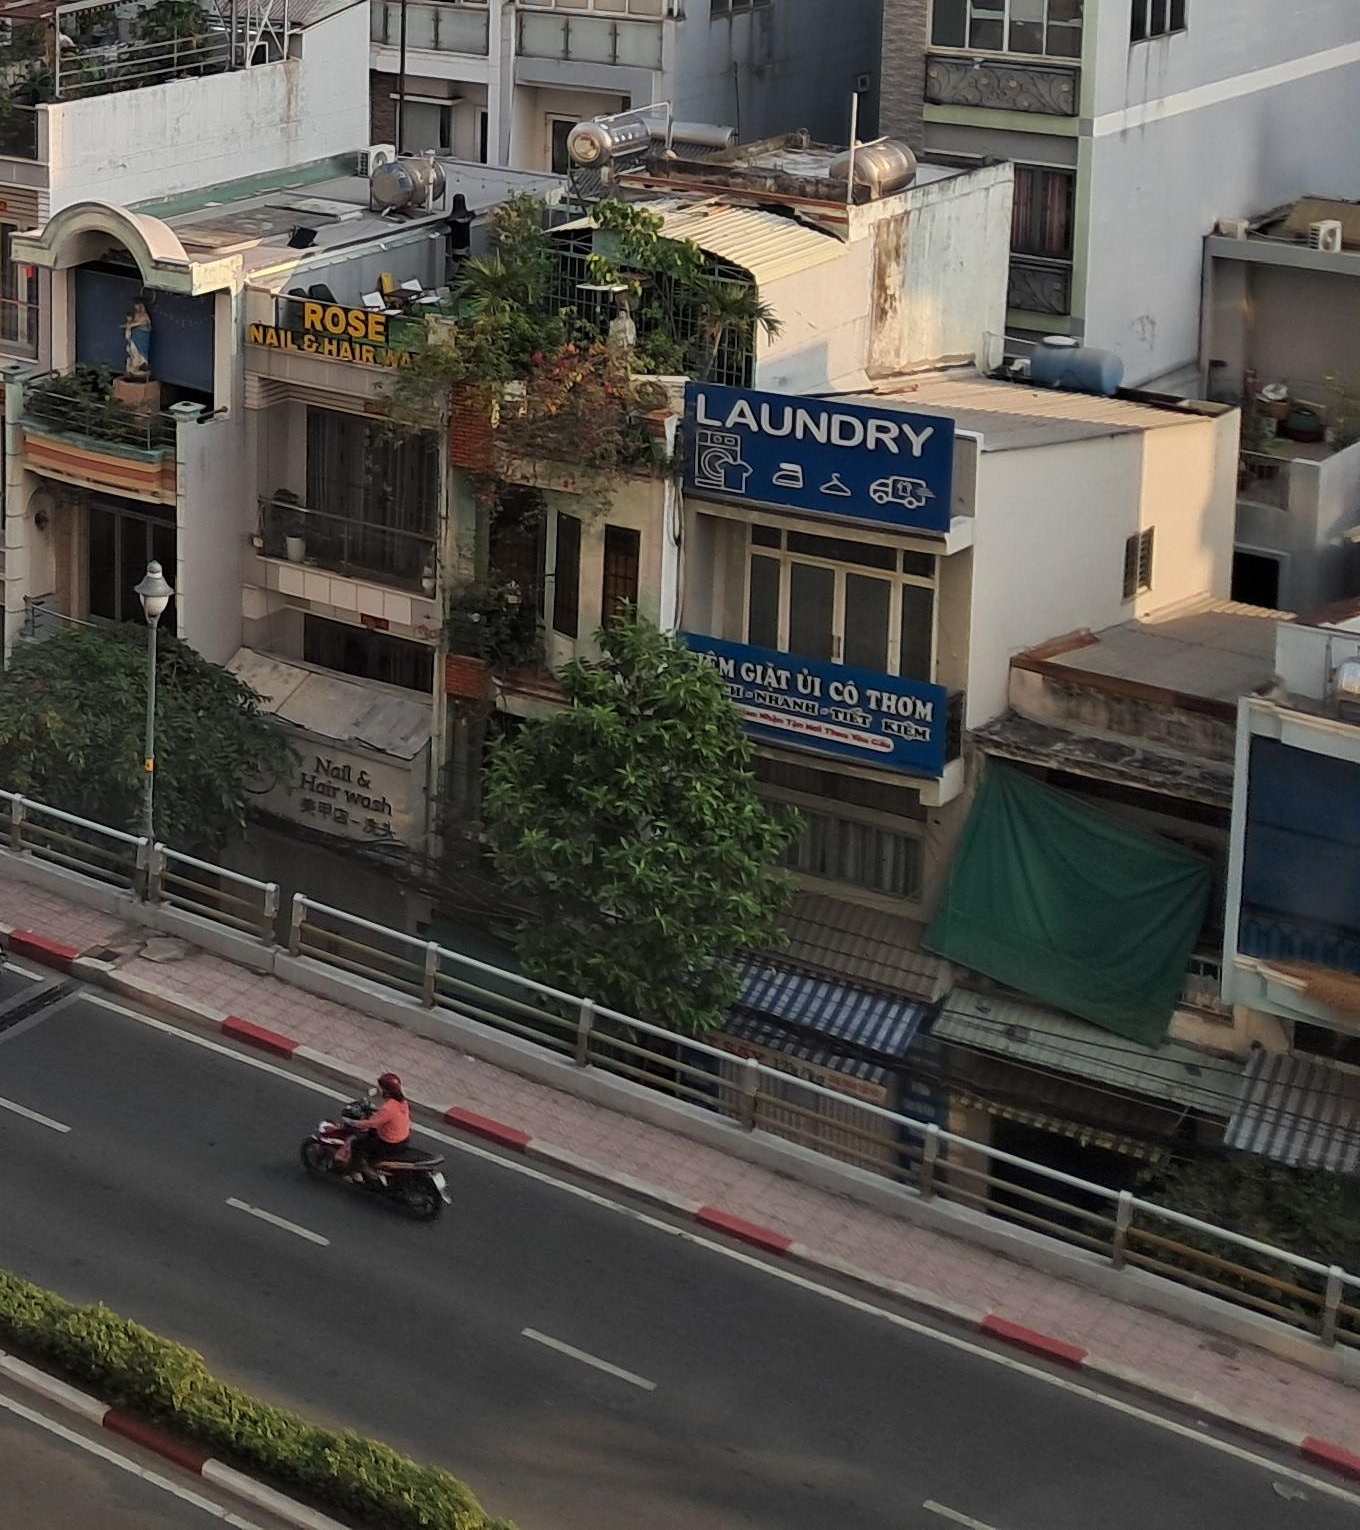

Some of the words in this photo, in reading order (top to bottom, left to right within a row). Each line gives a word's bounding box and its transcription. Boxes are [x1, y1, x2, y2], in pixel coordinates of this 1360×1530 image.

[304, 301, 387, 343] ROSE
[248, 323, 298, 351] NAIL
[303, 334, 321, 353] &
[323, 336, 376, 365] HAIR
[696, 393, 935, 458] LAUNDRY
[755, 690, 819, 715] NHANH
[829, 680, 859, 706] CÔ
[866, 689, 934, 722] THƠM
[315, 756, 352, 783] Nail
[356, 770, 371, 789] &
[300, 772, 341, 799] Hair
[344, 789, 393, 817] wash
